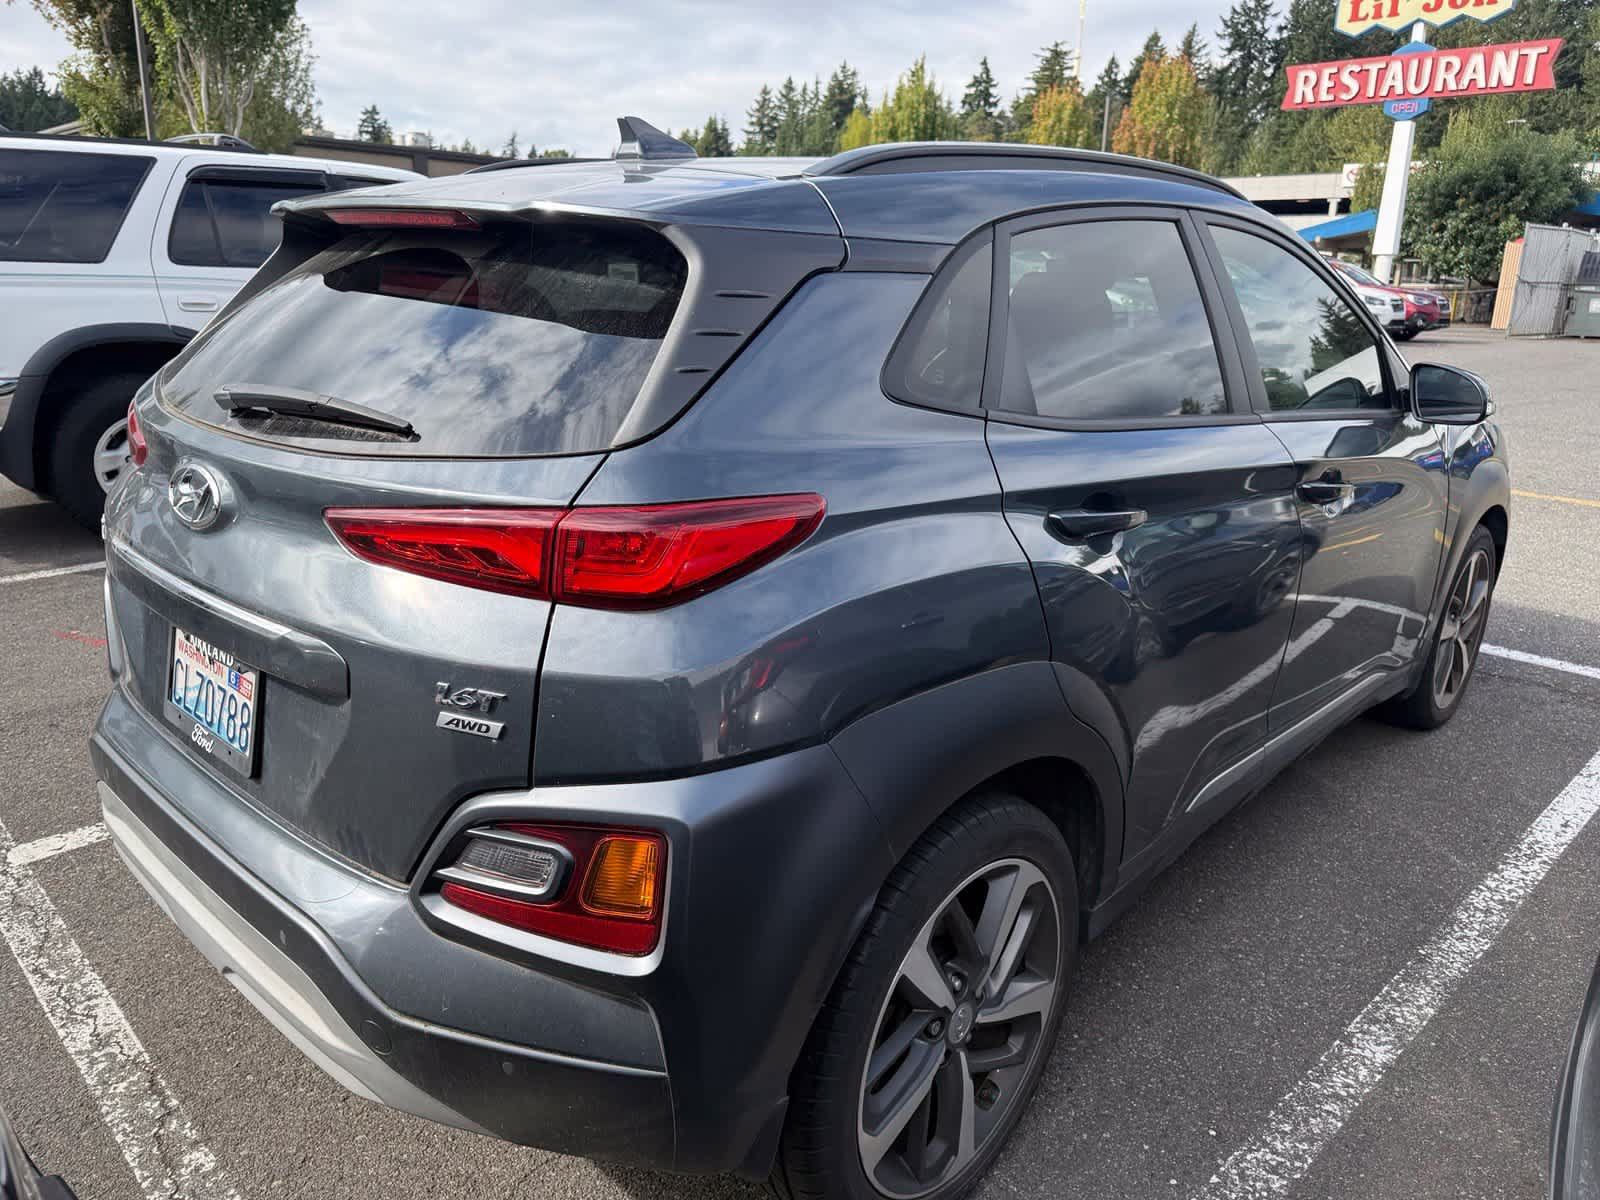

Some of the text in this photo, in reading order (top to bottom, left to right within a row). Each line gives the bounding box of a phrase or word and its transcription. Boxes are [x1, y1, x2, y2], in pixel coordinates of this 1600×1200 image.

[1293, 45, 1549, 104] RESTAURANT
[1391, 101, 1418, 114] OPEN
[173, 658, 251, 753] CLZ0788
[434, 681, 507, 712] 1.6T
[191, 723, 214, 753] Ford
[444, 717, 491, 734] AWD
